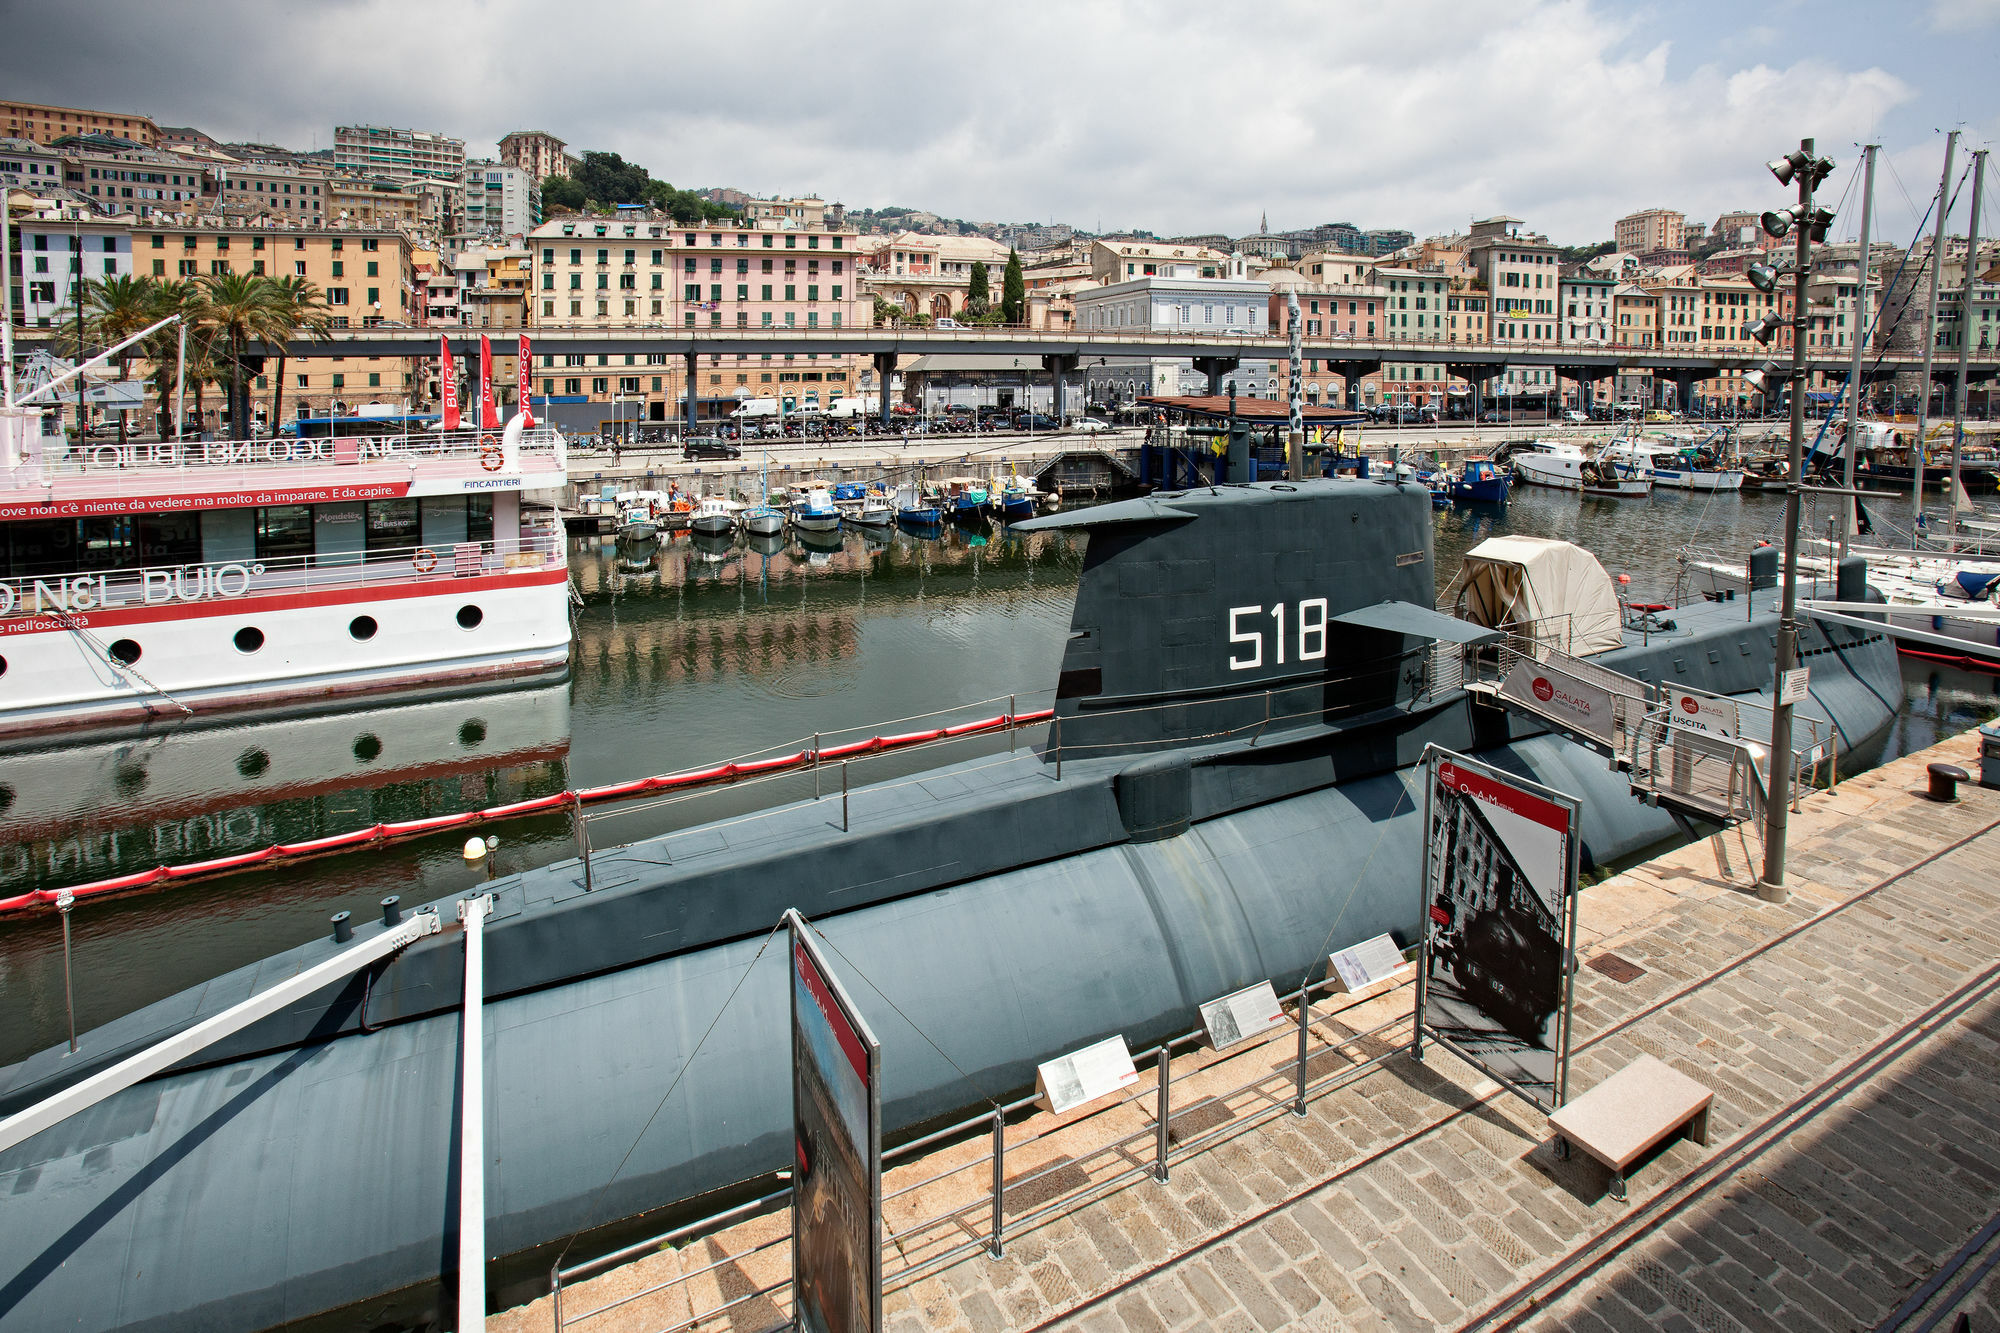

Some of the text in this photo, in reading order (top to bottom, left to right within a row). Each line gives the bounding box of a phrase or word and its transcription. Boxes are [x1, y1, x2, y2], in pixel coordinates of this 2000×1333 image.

[446, 367, 457, 408] BUIO
[464, 478, 521, 489] FINCANTIERI
[0, 506, 26, 517] ove
[30, 505, 58, 516] non
[84, 500, 126, 512] niente
[129, 499, 145, 510] da
[148, 497, 192, 509] vedere
[194, 496, 214, 507] ma
[217, 493, 253, 505] molto
[256, 492, 272, 503] da
[274, 490, 329, 503] imparare.
[332, 488, 340, 499] E
[342, 487, 356, 499] da
[358, 486, 395, 499] capire.
[34, 575, 126, 613] NEL
[8, 615, 89, 632] nell'oscuità
[1229, 597, 1328, 671] 518
[1555, 689, 1591, 711] GALATA
[1673, 715, 1708, 731] USCITA
